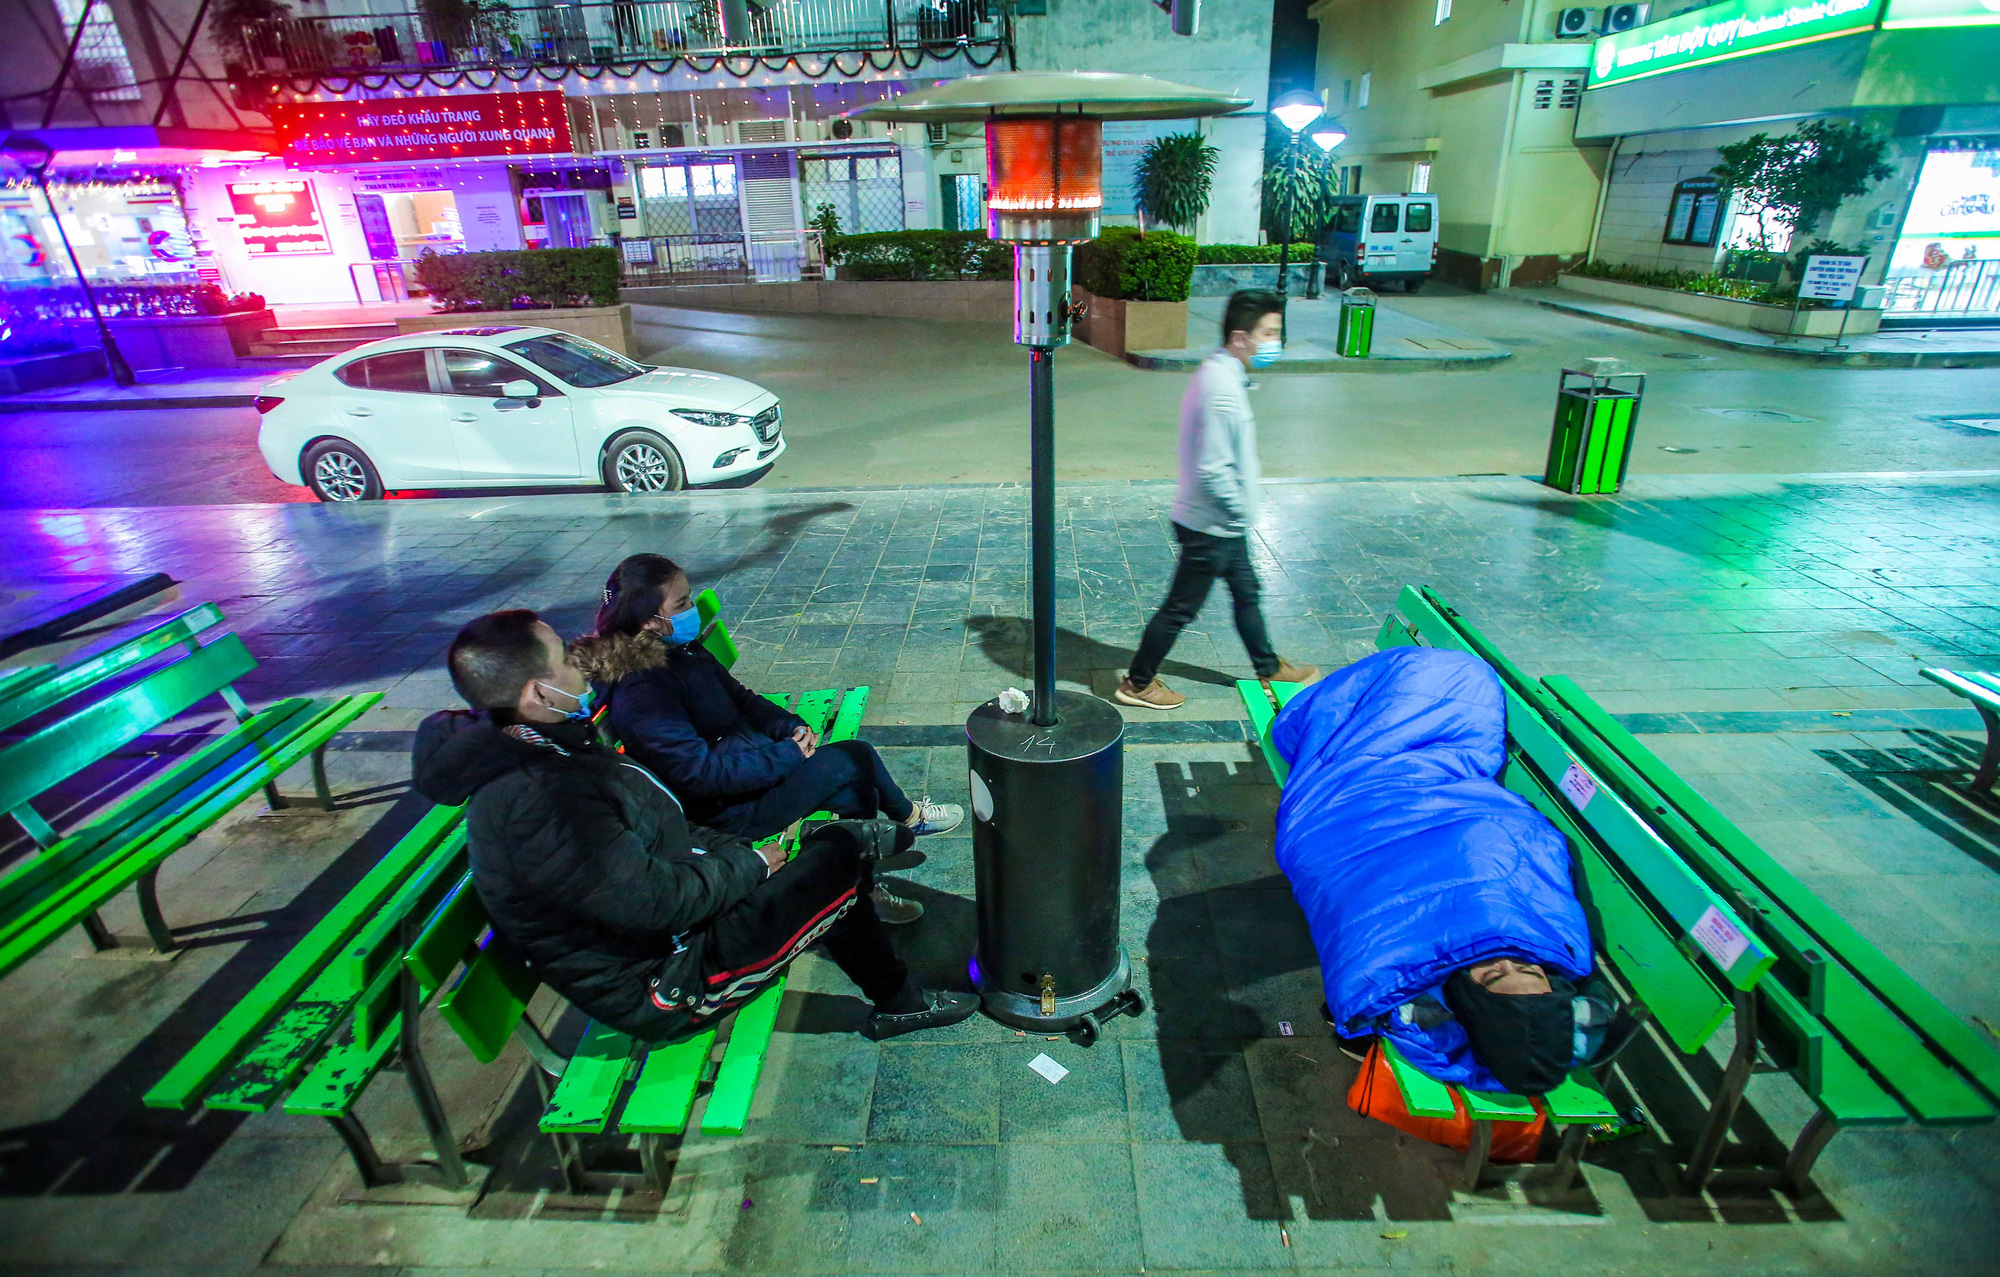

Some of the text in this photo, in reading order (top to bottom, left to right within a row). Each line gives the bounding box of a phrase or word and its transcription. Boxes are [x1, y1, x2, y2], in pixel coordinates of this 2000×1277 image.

[357, 109, 481, 127] HÃY ĐEO KHẨU TRANG
[293, 127, 556, 151] ĐỂ BẢO VỆ BẠN VÀ NHỮNG NGƯỜI XUNG QUANH
[1020, 734, 1056, 755] 14
